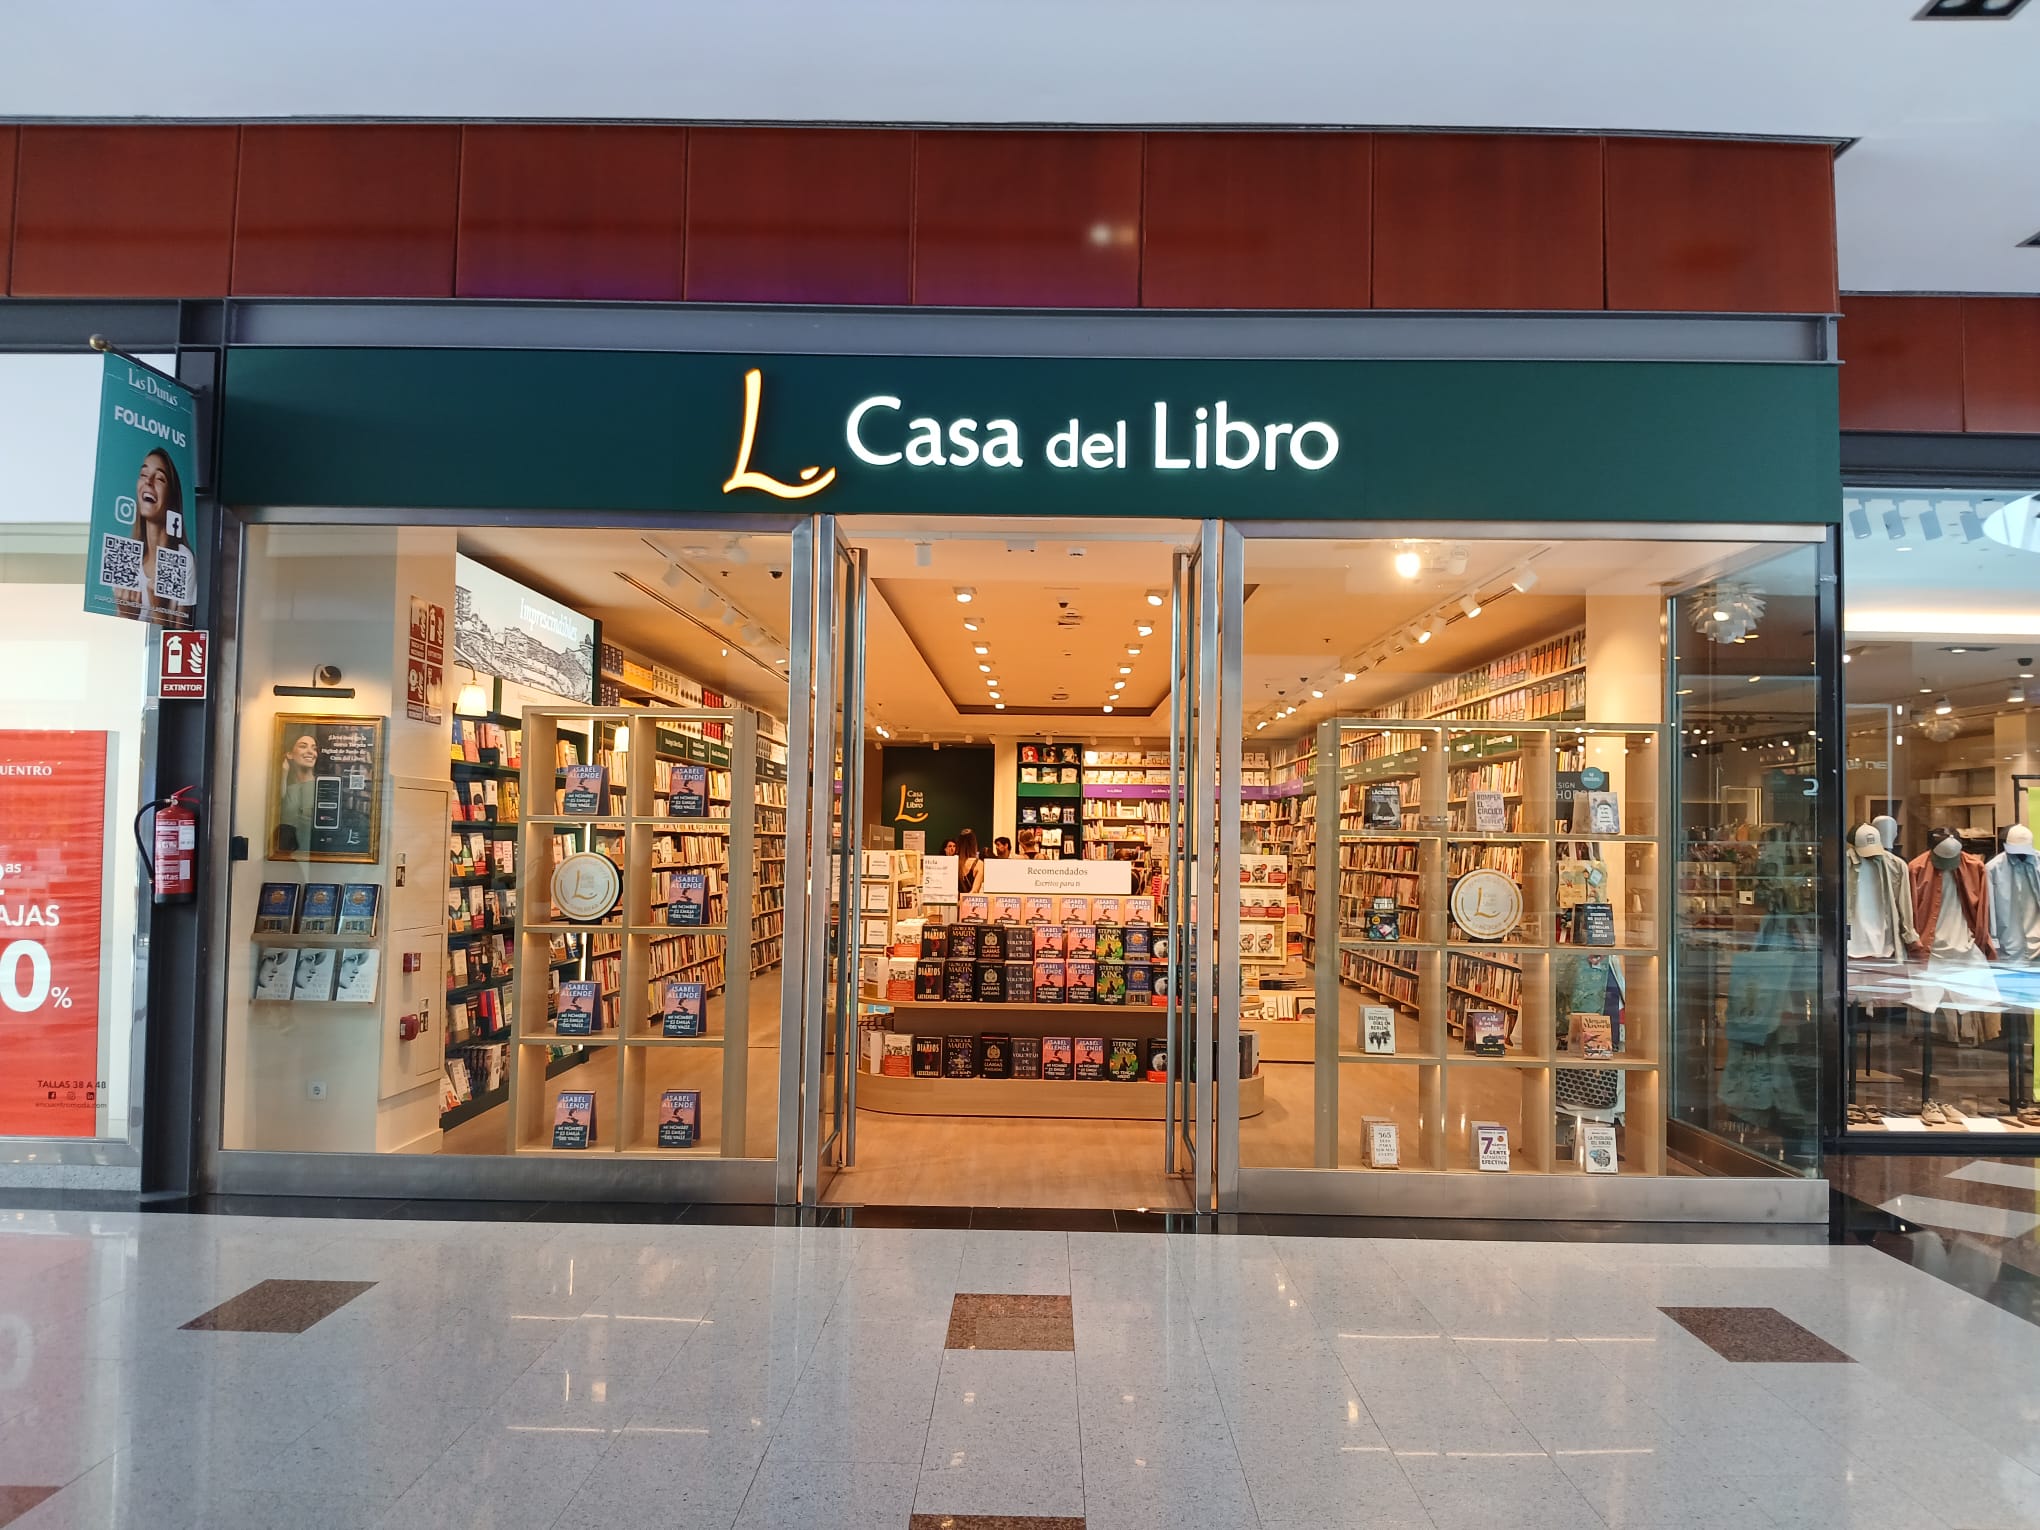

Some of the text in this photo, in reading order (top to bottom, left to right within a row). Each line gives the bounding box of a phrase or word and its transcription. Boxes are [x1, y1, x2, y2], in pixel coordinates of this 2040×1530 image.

[114, 404, 186, 448] FOLLOW US
[845, 394, 1340, 472] Casa del Libro
[163, 684, 203, 692] EXTINTOR
[0, 765, 52, 776] UENTRO
[1027, 866, 1088, 876] Recomendados
[0, 904, 61, 927] AJAS
[38, 1080, 70, 1089] TALLAS
[72, 1080, 84, 1089] 38
[86, 1080, 93, 1089] A
[1481, 1137, 1493, 1154] 7
